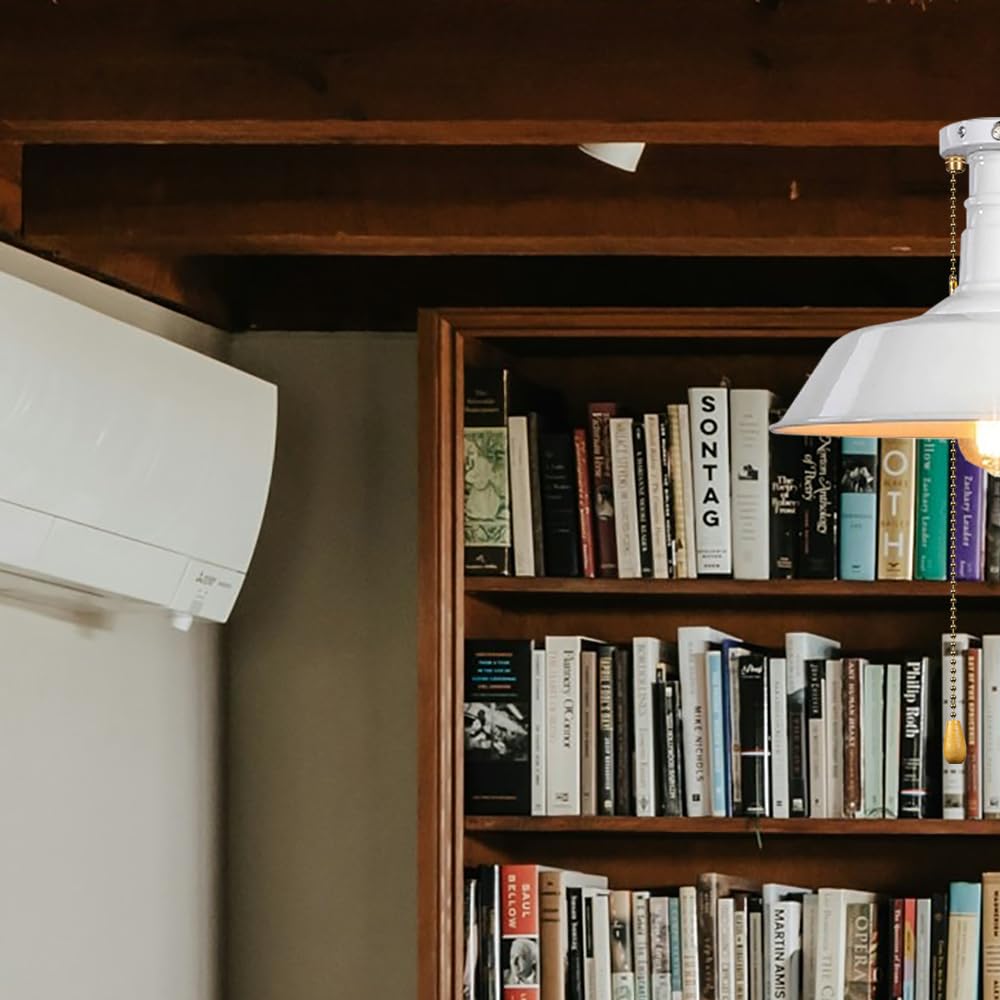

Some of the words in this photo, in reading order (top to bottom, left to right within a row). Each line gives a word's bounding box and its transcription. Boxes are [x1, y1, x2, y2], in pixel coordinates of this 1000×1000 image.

[700, 396, 720, 526] SONTAG
[802, 454, 814, 467] of
[818, 436, 832, 476] Norton
[802, 467, 817, 501] Poetry
[921, 478, 931, 513] Zachary
[963, 476, 973, 512] Zachary
[814, 476, 831, 533] Anthology
[921, 517, 930, 547] Leader
[963, 514, 972, 546] Leader
[904, 661, 920, 703] Philip
[695, 706, 703, 731] MIKE
[905, 707, 919, 738] Roth
[695, 736, 704, 782] NICHOLS
[508, 875, 516, 928] BELLOW
[521, 884, 530, 918] SAUL
[774, 909, 785, 961] MARTIN
[854, 916, 868, 981] OPERA
[775, 965, 785, 999] AMIS
